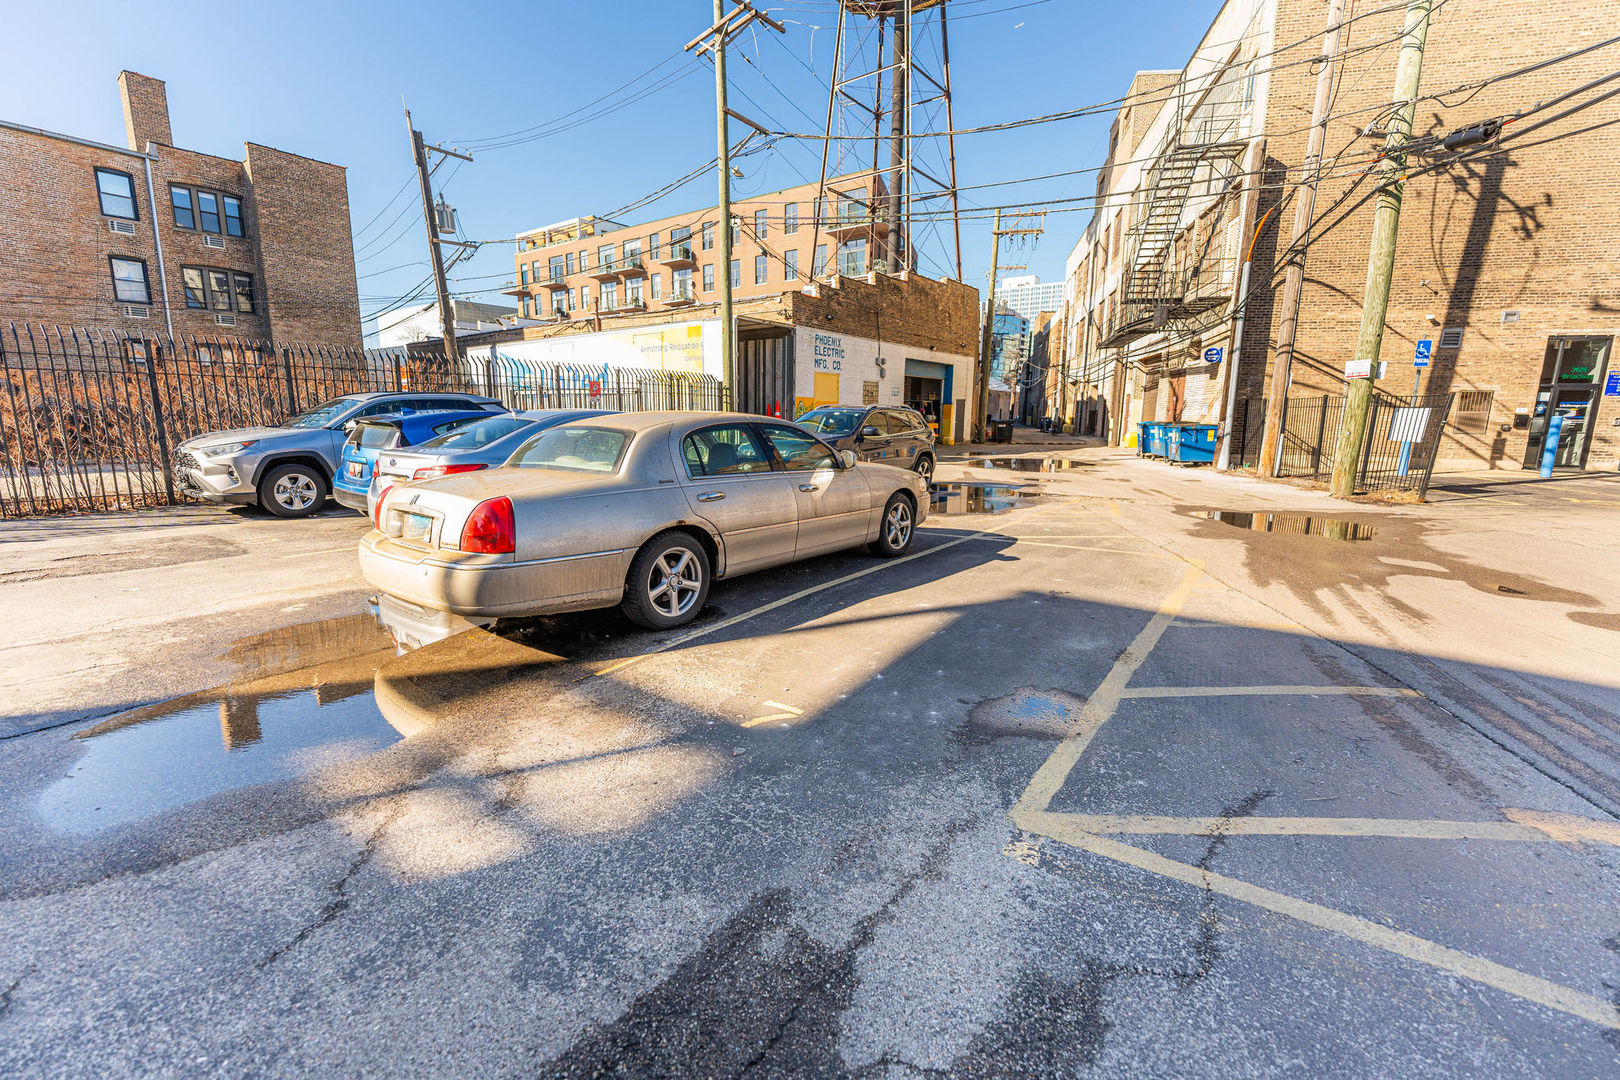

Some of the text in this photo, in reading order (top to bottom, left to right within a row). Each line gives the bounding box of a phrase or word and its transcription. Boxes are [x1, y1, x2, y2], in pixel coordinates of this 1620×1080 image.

[814, 333, 841, 347] PHOENIX
[640, 345, 668, 353] Armstrong
[669, 342, 699, 350] Relocation
[814, 345, 845, 359] ELECTRIC
[814, 358, 843, 371] MFG. CO.
